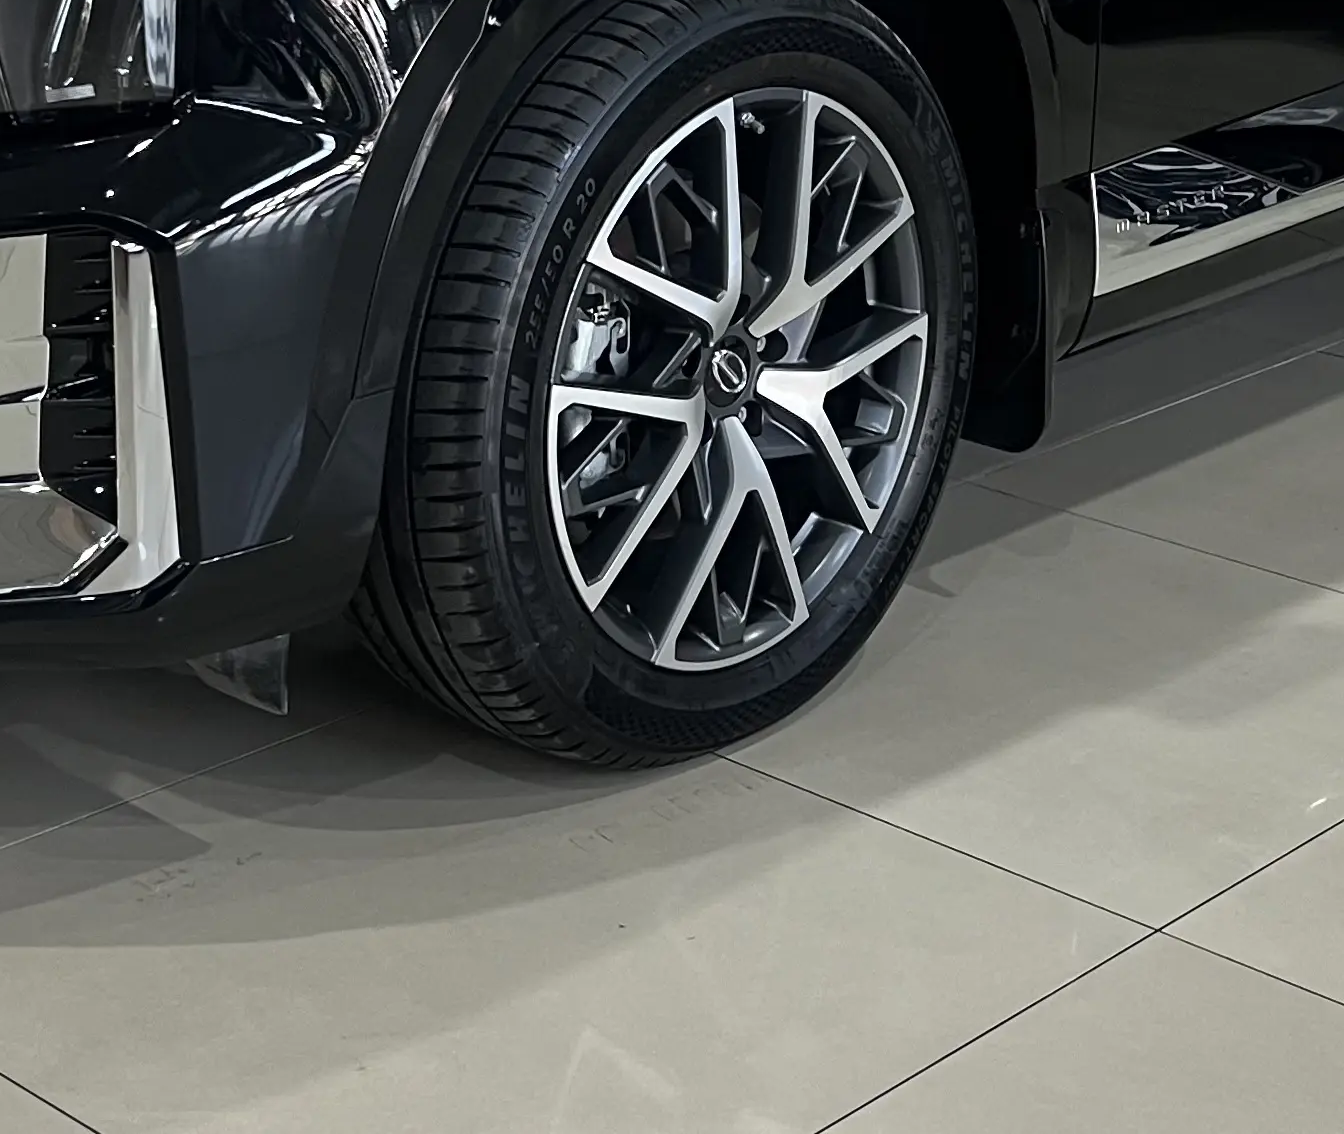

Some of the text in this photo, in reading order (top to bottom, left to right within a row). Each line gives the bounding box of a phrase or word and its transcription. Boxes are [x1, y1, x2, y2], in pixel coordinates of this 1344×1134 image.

[525, 176, 598, 350] 255/50 R 20
[940, 156, 974, 382] MICHELIN
